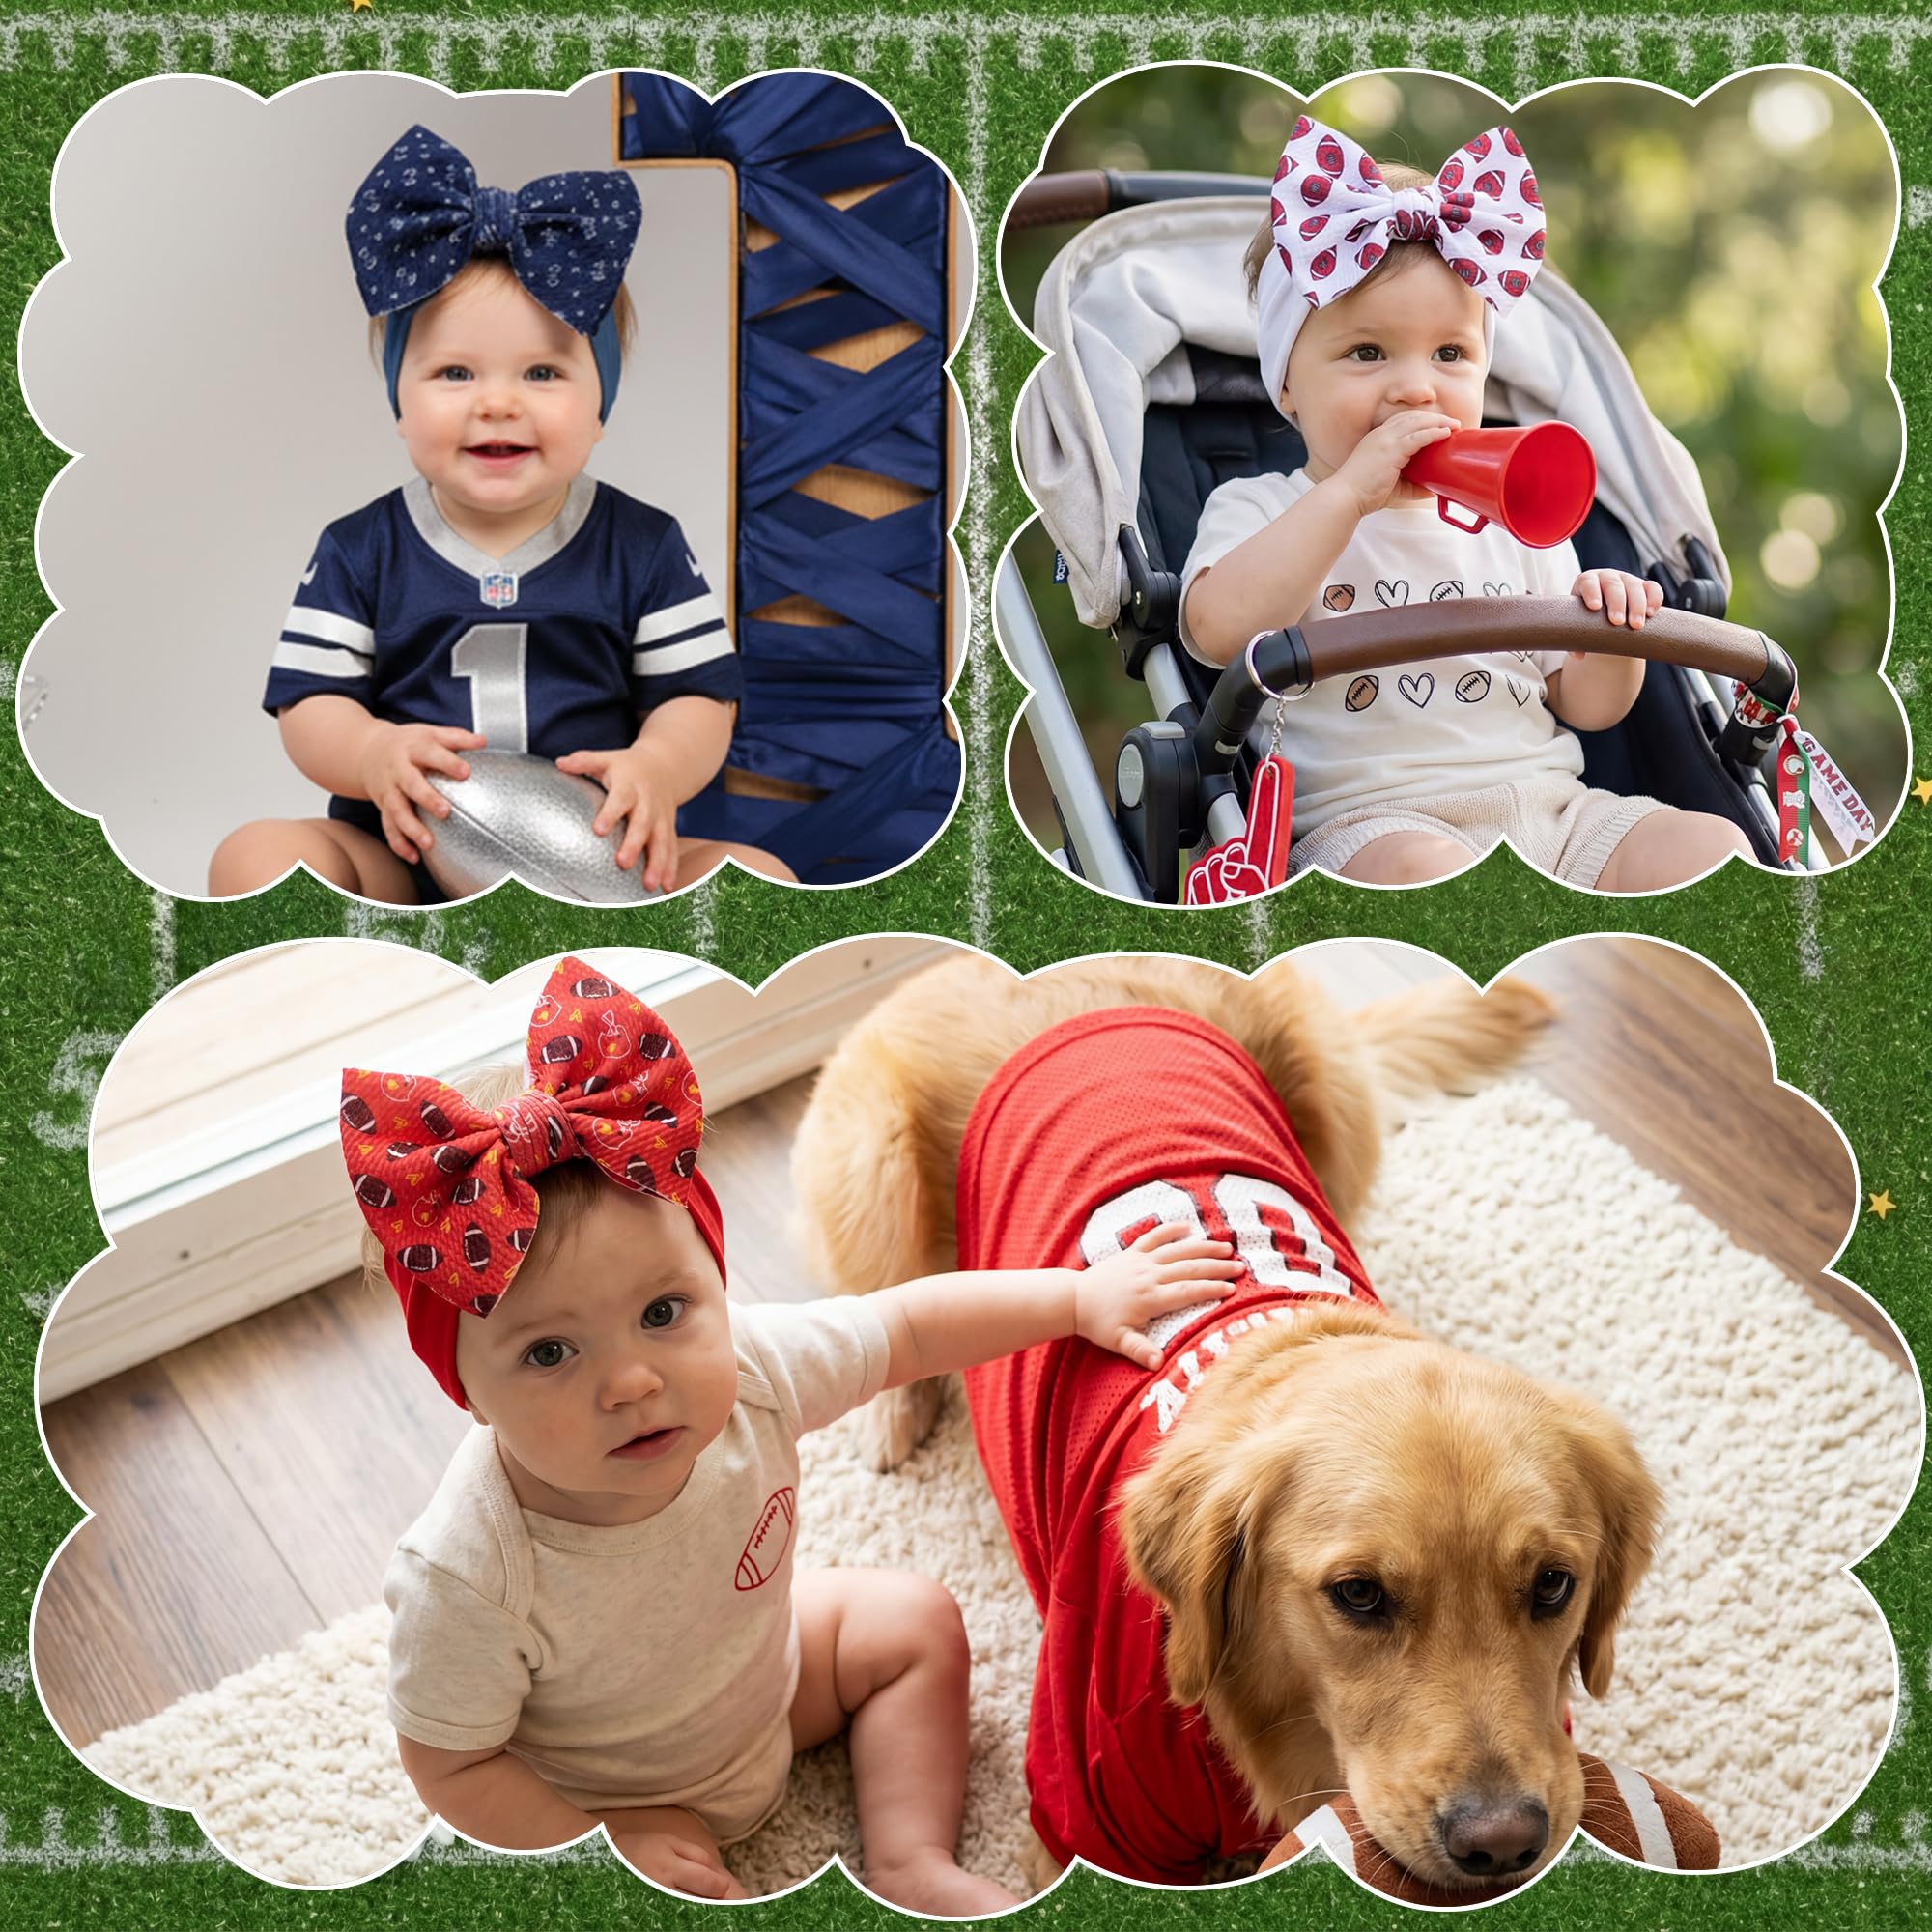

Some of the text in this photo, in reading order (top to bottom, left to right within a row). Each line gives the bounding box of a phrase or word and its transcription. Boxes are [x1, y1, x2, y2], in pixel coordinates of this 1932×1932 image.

[451, 623, 528, 753] 1
[1802, 737, 1874, 831] GAME DAY
